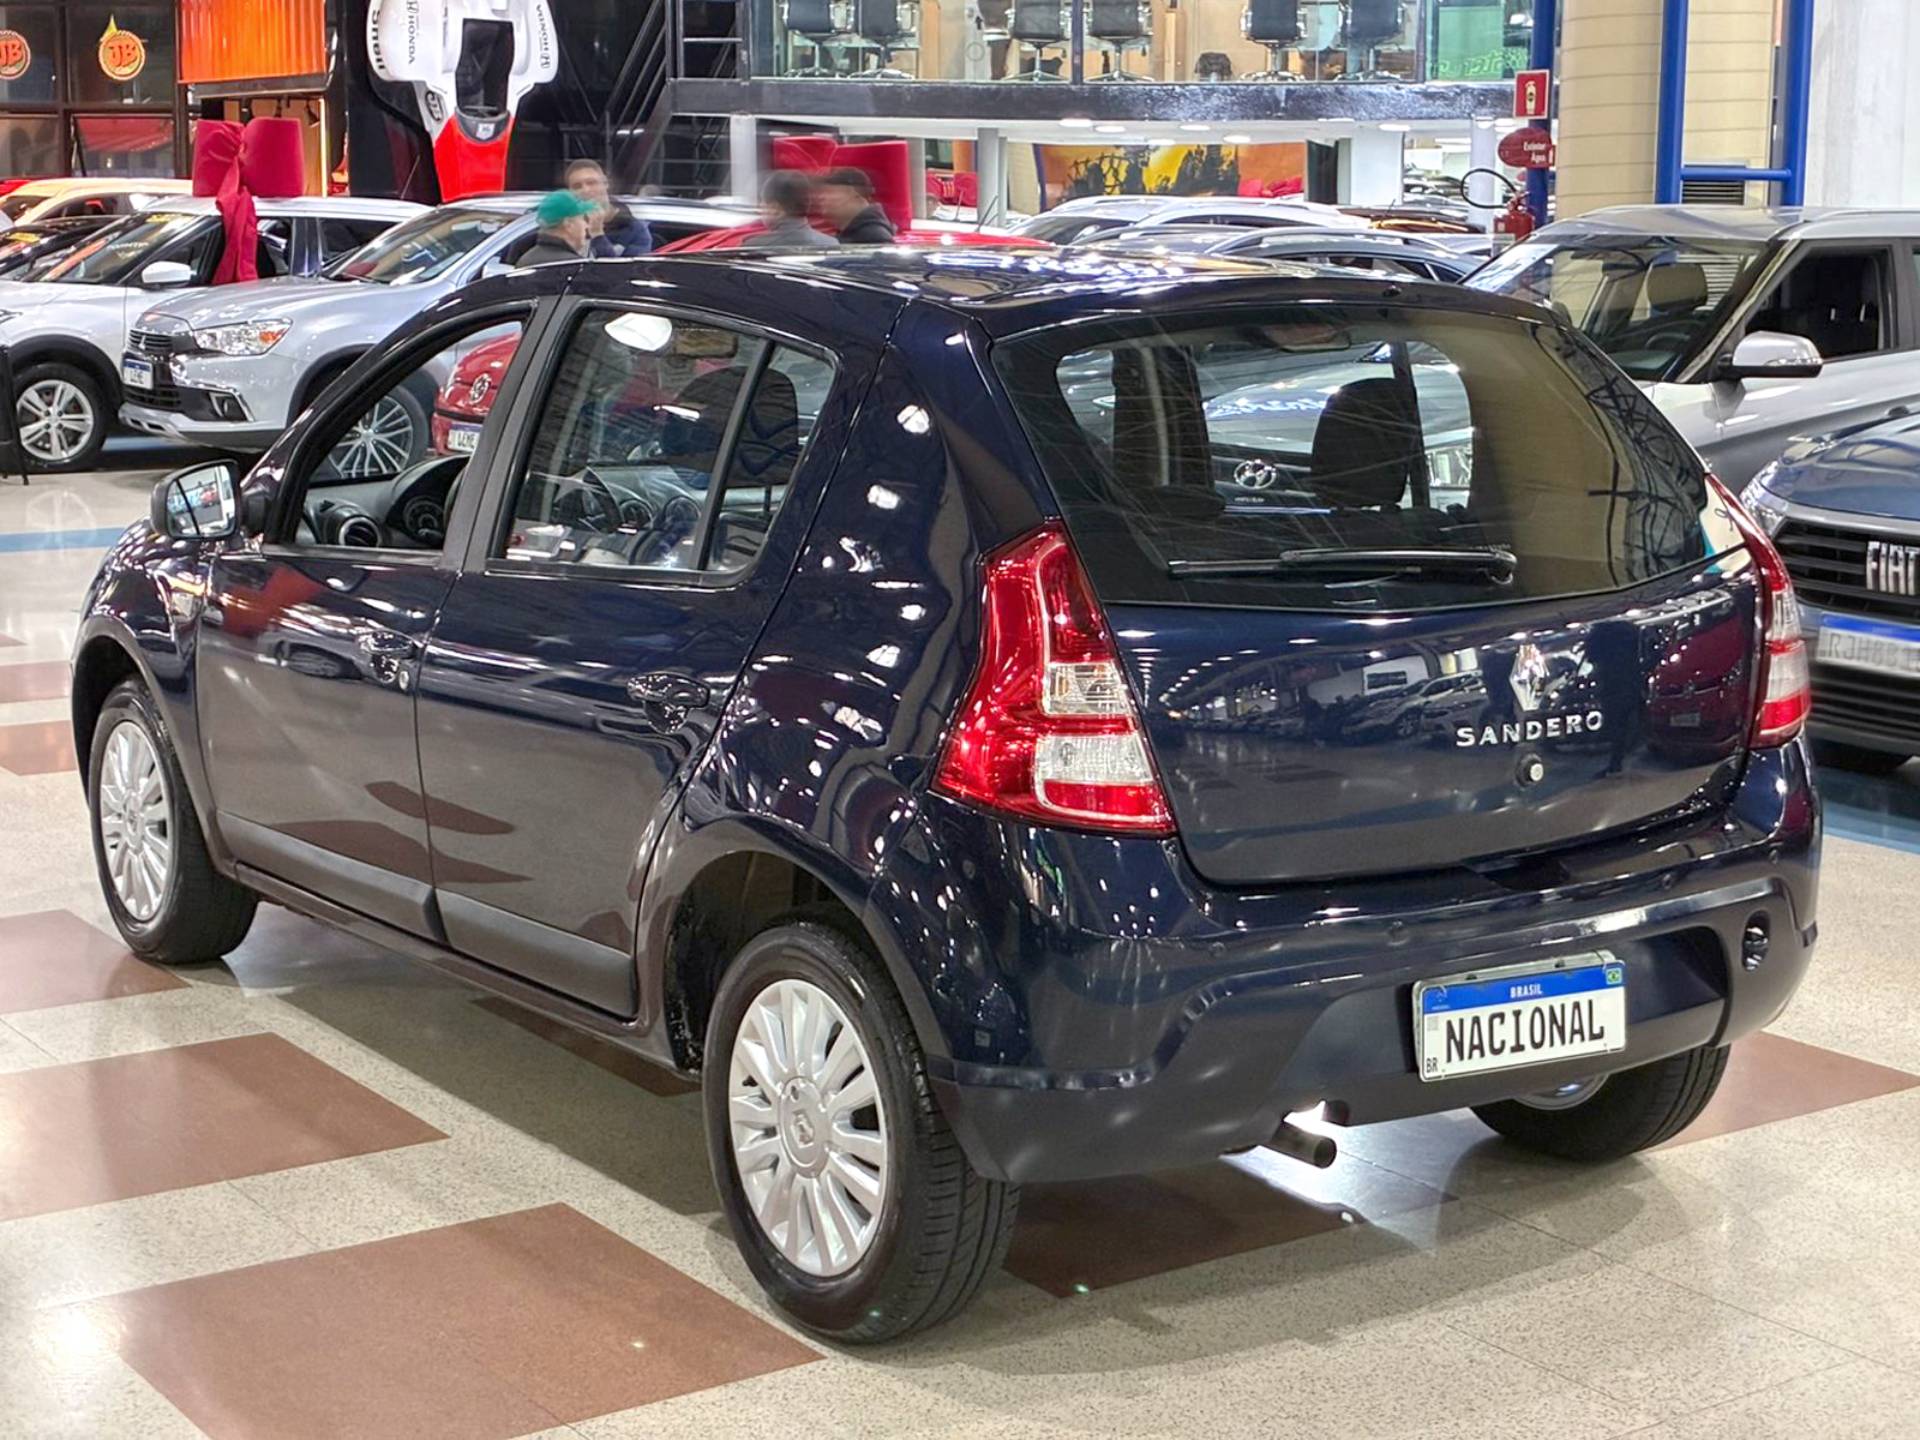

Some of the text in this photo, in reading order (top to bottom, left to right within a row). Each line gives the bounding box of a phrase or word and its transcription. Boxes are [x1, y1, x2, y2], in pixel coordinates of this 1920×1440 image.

[408, 15, 416, 64] HONDA
[536, 5, 549, 51] HONDA
[1866, 541, 1920, 596] FIAT
[1456, 710, 1603, 747] SANDERO
[1510, 983, 1543, 998] BRASIL
[1446, 999, 1604, 1063] NACIONAL
[1426, 1057, 1438, 1073] BR
